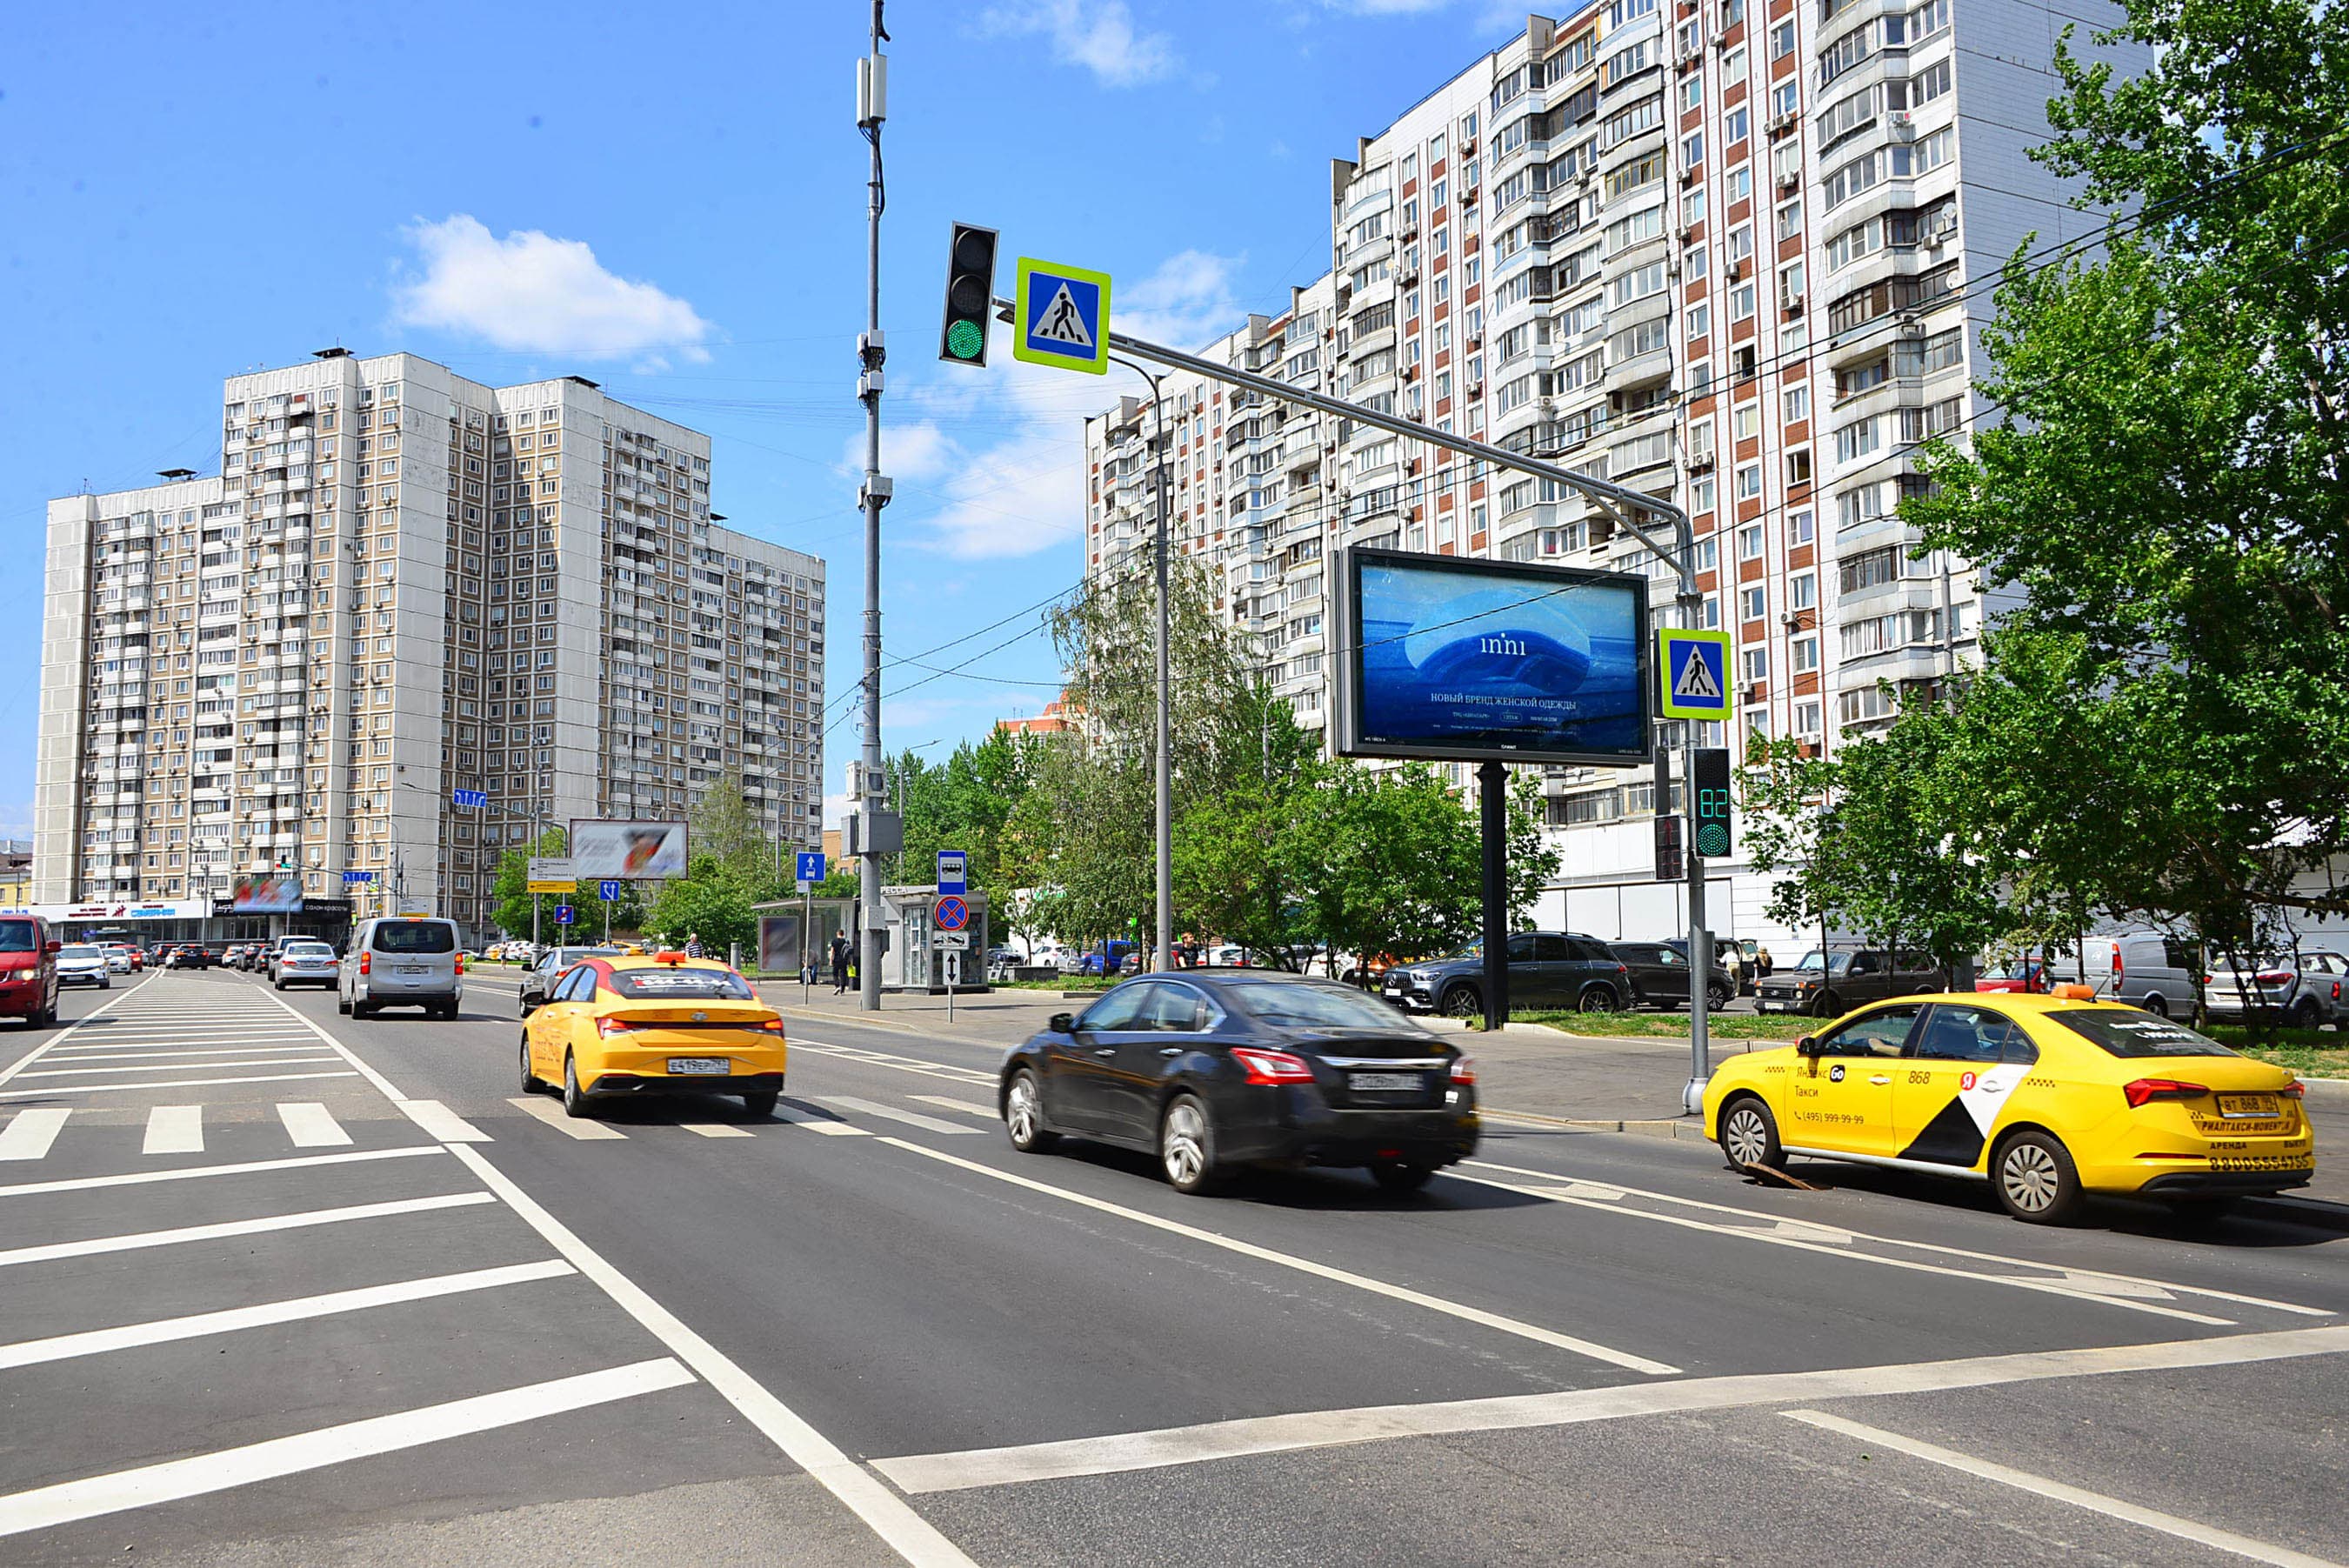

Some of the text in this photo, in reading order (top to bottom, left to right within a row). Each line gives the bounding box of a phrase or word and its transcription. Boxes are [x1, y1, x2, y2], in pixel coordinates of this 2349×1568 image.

[1431, 692, 1577, 711] НОВЫЙ БРЕНД ЖЕНСКОЙ ОДЕЖДЫ
[1700, 789, 1728, 817] 82
[879, 885, 908, 895] РЕССА
[1831, 1066, 1844, 1079] Go
[1907, 1071, 1932, 1084] 868
[1962, 1073, 1973, 1089] Я
[1795, 1085, 1818, 1098] Такси
[1803, 1111, 1865, 1124] (495) 999-99-99
[2209, 1141, 2247, 1150] АРЕНДА
